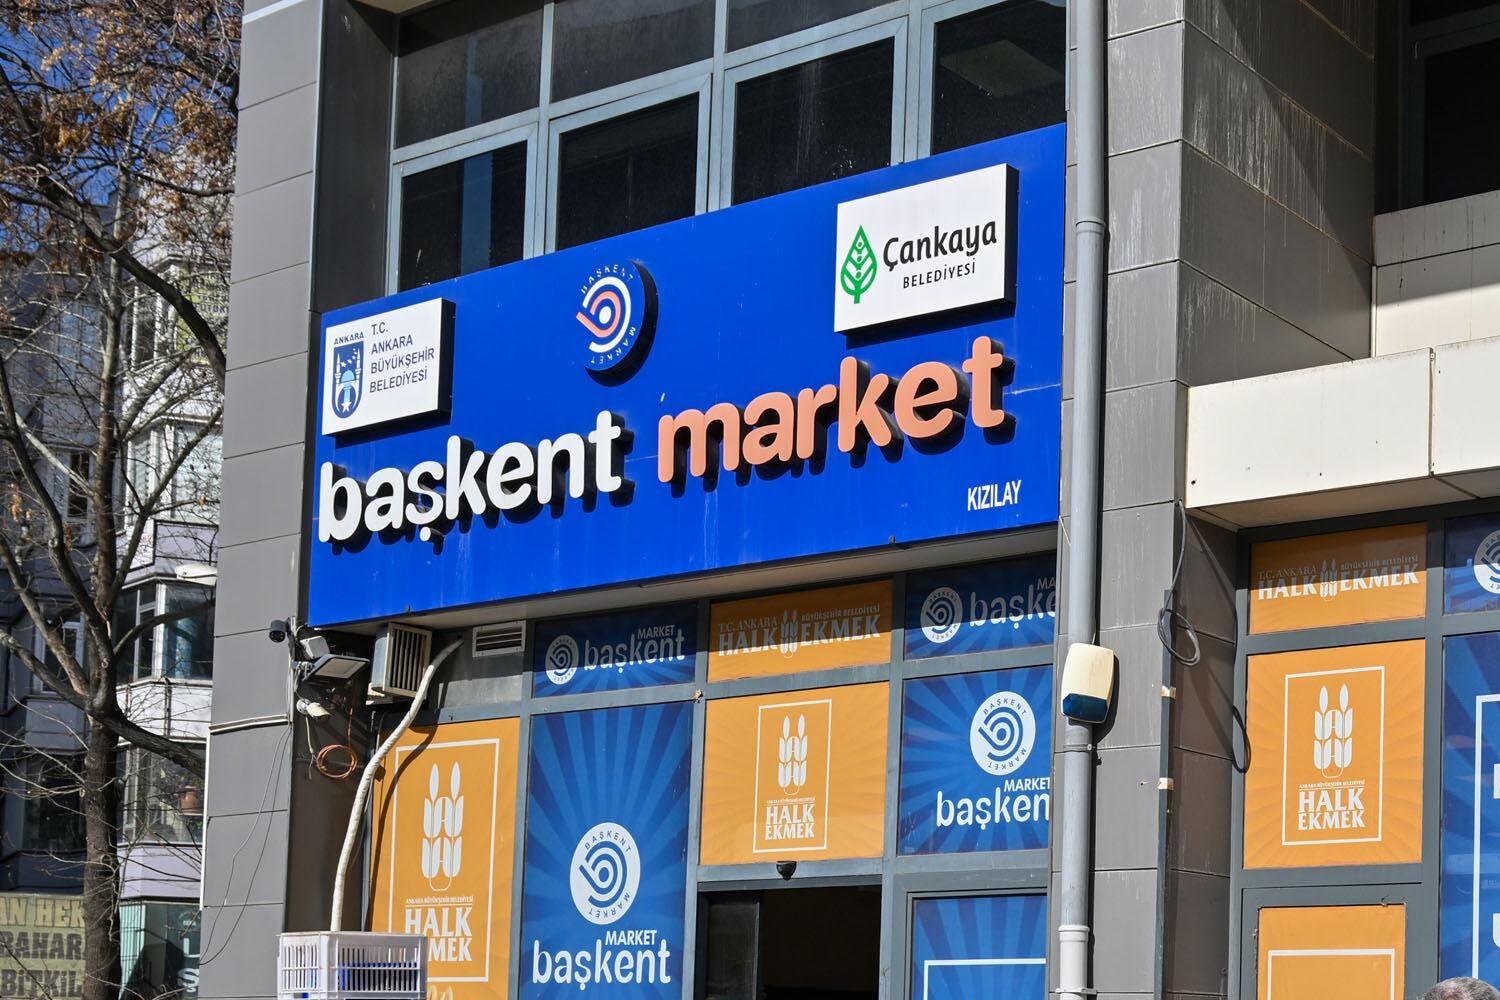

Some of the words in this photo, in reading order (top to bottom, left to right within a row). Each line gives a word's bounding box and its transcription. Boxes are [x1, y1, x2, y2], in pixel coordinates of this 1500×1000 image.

[882, 220, 997, 272] Çankaya
[903, 257, 976, 289] BELEDİYESİ
[334, 332, 365, 346] ANKARA
[371, 321, 389, 336] T.C.
[371, 334, 413, 356] ANKARA
[371, 346, 435, 375] BÜYÜKŞEHİR
[369, 365, 429, 393] BELEDİYESİ
[318, 410, 623, 543] başkent
[657, 335, 1004, 484] market
[967, 479, 1022, 512] KIZILAY
[1258, 575, 1318, 601] HALK
[1340, 563, 1420, 592] EKMEK
[1278, 565, 1317, 579] ANKARA
[637, 624, 676, 640] MARKET
[718, 627, 778, 657] HALK
[800, 614, 881, 647] EKMEK
[738, 616, 778, 631] ANKARA
[584, 628, 686, 674] başkent
[982, 698, 1027, 715] BAŞKENT
[988, 747, 1027, 770] MARKET
[1298, 787, 1365, 813] HALK
[765, 803, 816, 825] HALK
[1297, 810, 1366, 831] EKMEK
[584, 830, 632, 853] BAŞKENT
[765, 822, 816, 841] EKMEK
[588, 893, 631, 918] MARKET
[405, 907, 473, 937] HALK
[428, 937, 473, 962] MEK
[605, 930, 658, 946] MARKET
[532, 938, 671, 991] başkent
